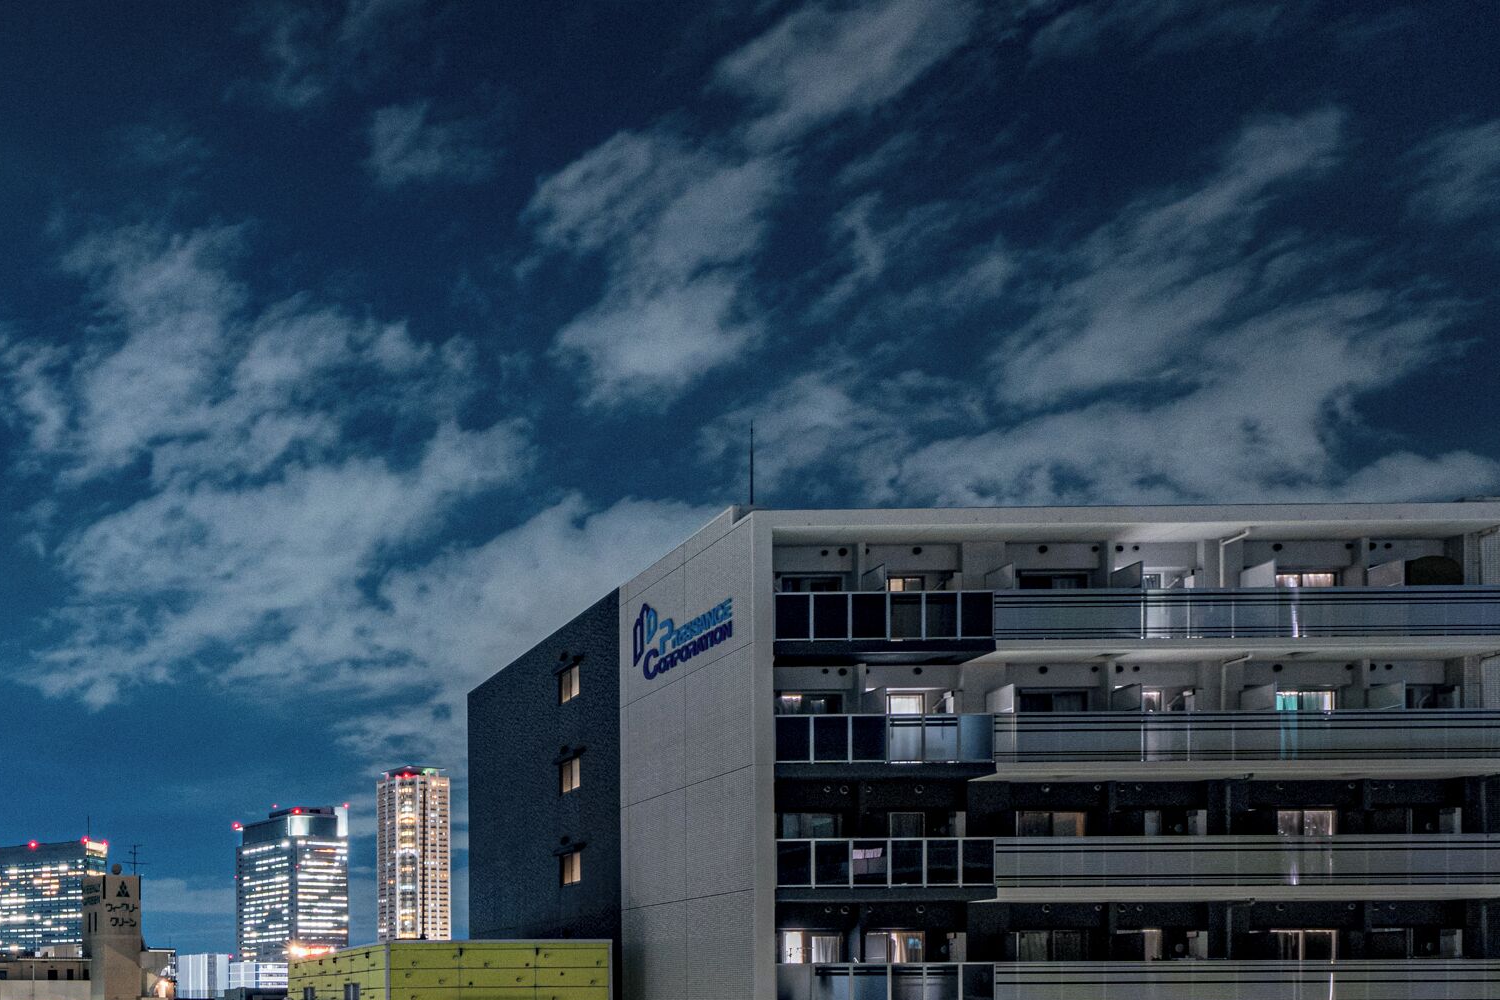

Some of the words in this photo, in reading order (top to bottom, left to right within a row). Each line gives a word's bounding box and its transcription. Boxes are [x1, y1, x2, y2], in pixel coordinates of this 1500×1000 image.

[658, 597, 733, 656] PRESSANCE
[642, 620, 733, 680] CORPORATION
[105, 903, 139, 912] ウィークリー
[110, 917, 137, 927] クリーン
